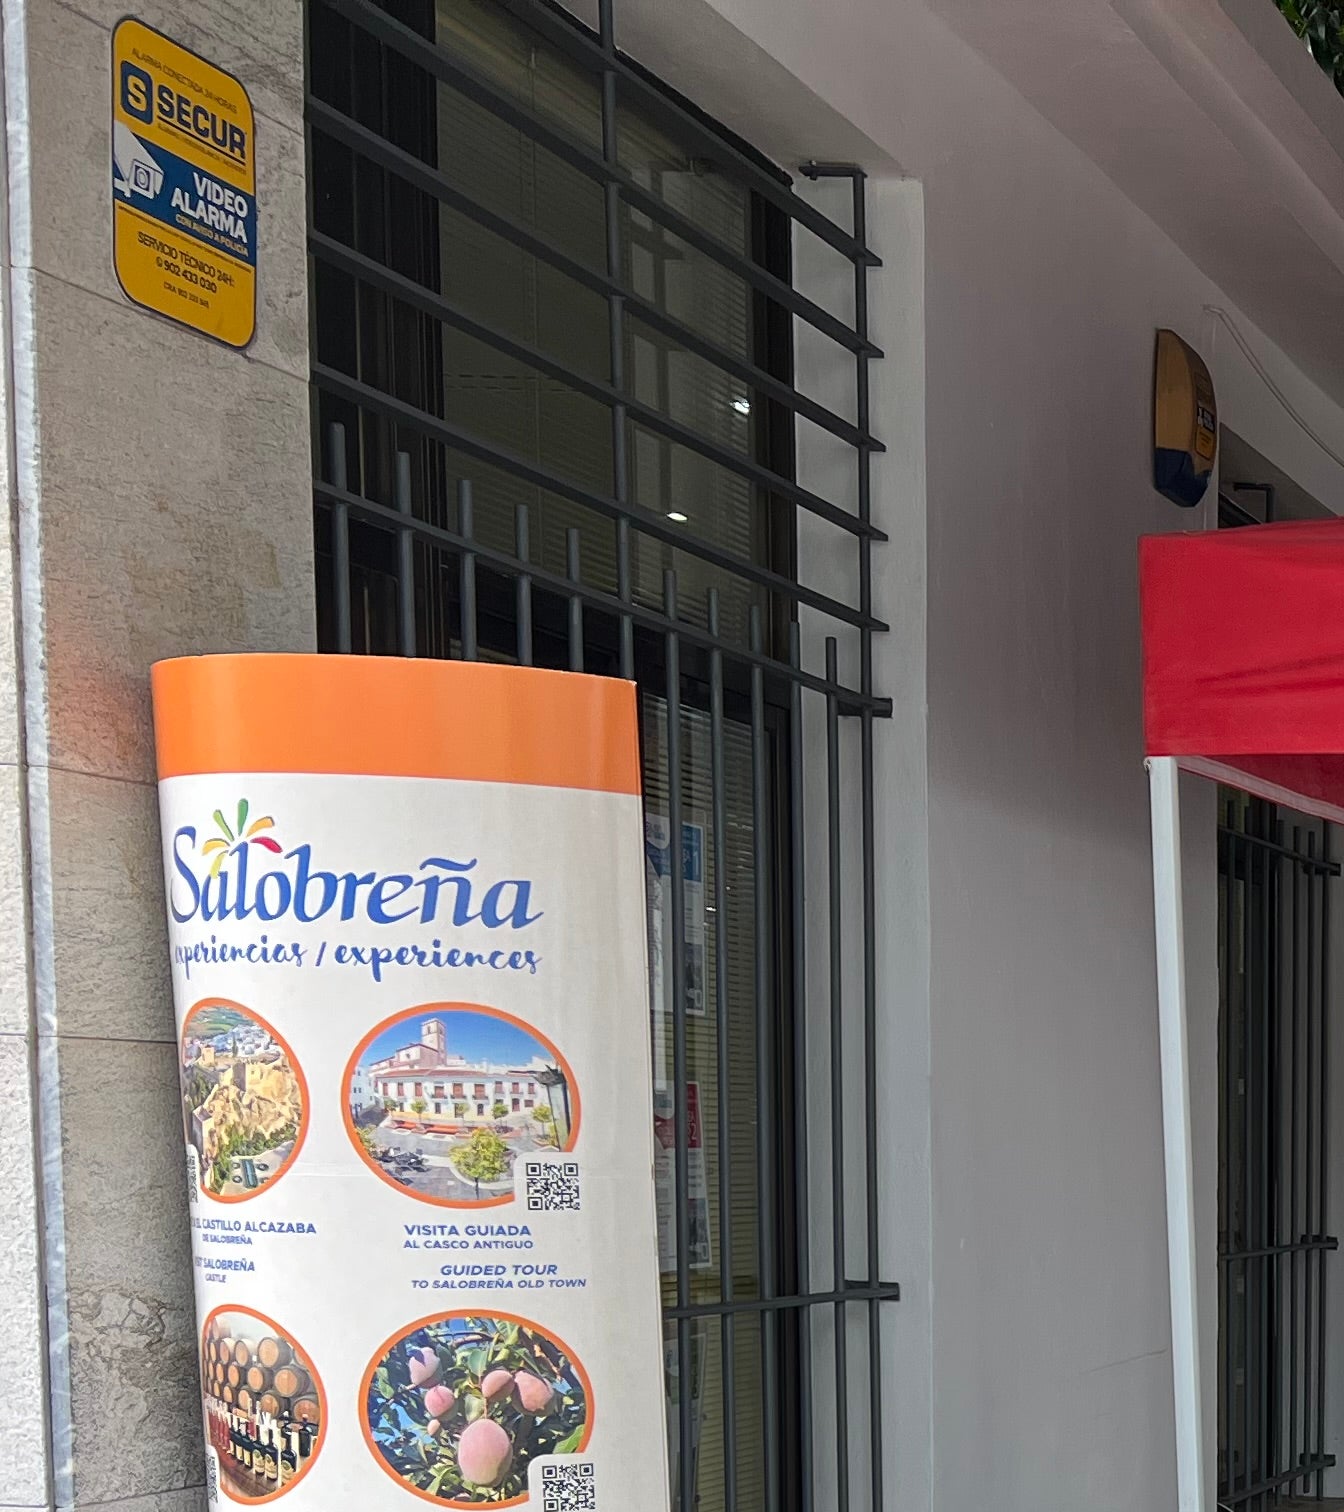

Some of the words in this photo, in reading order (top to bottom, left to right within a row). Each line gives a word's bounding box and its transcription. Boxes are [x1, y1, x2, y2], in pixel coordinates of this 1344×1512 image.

[157, 84, 246, 159] SECUR
[193, 172, 248, 218] VIDEO
[171, 187, 247, 243] ALARMA
[137, 231, 177, 259] SERVICIO
[164, 260, 181, 277] 902
[171, 825, 544, 929] Salobreña
[335, 938, 543, 983] experiences
[245, 1222, 316, 1233] ALCAZABA
[404, 1225, 459, 1236] VISITA
[464, 1225, 531, 1236] GUIADA
[403, 1240, 420, 1249] AL
[424, 1241, 469, 1249] CASCO
[473, 1241, 533, 1249] ANTIGUO
[440, 1265, 506, 1275] GUIDED
[512, 1265, 558, 1275] TOUR
[432, 1278, 513, 1288] SALOBREÑA
[518, 1280, 544, 1288] OLD
[549, 1279, 587, 1288] TOWN
